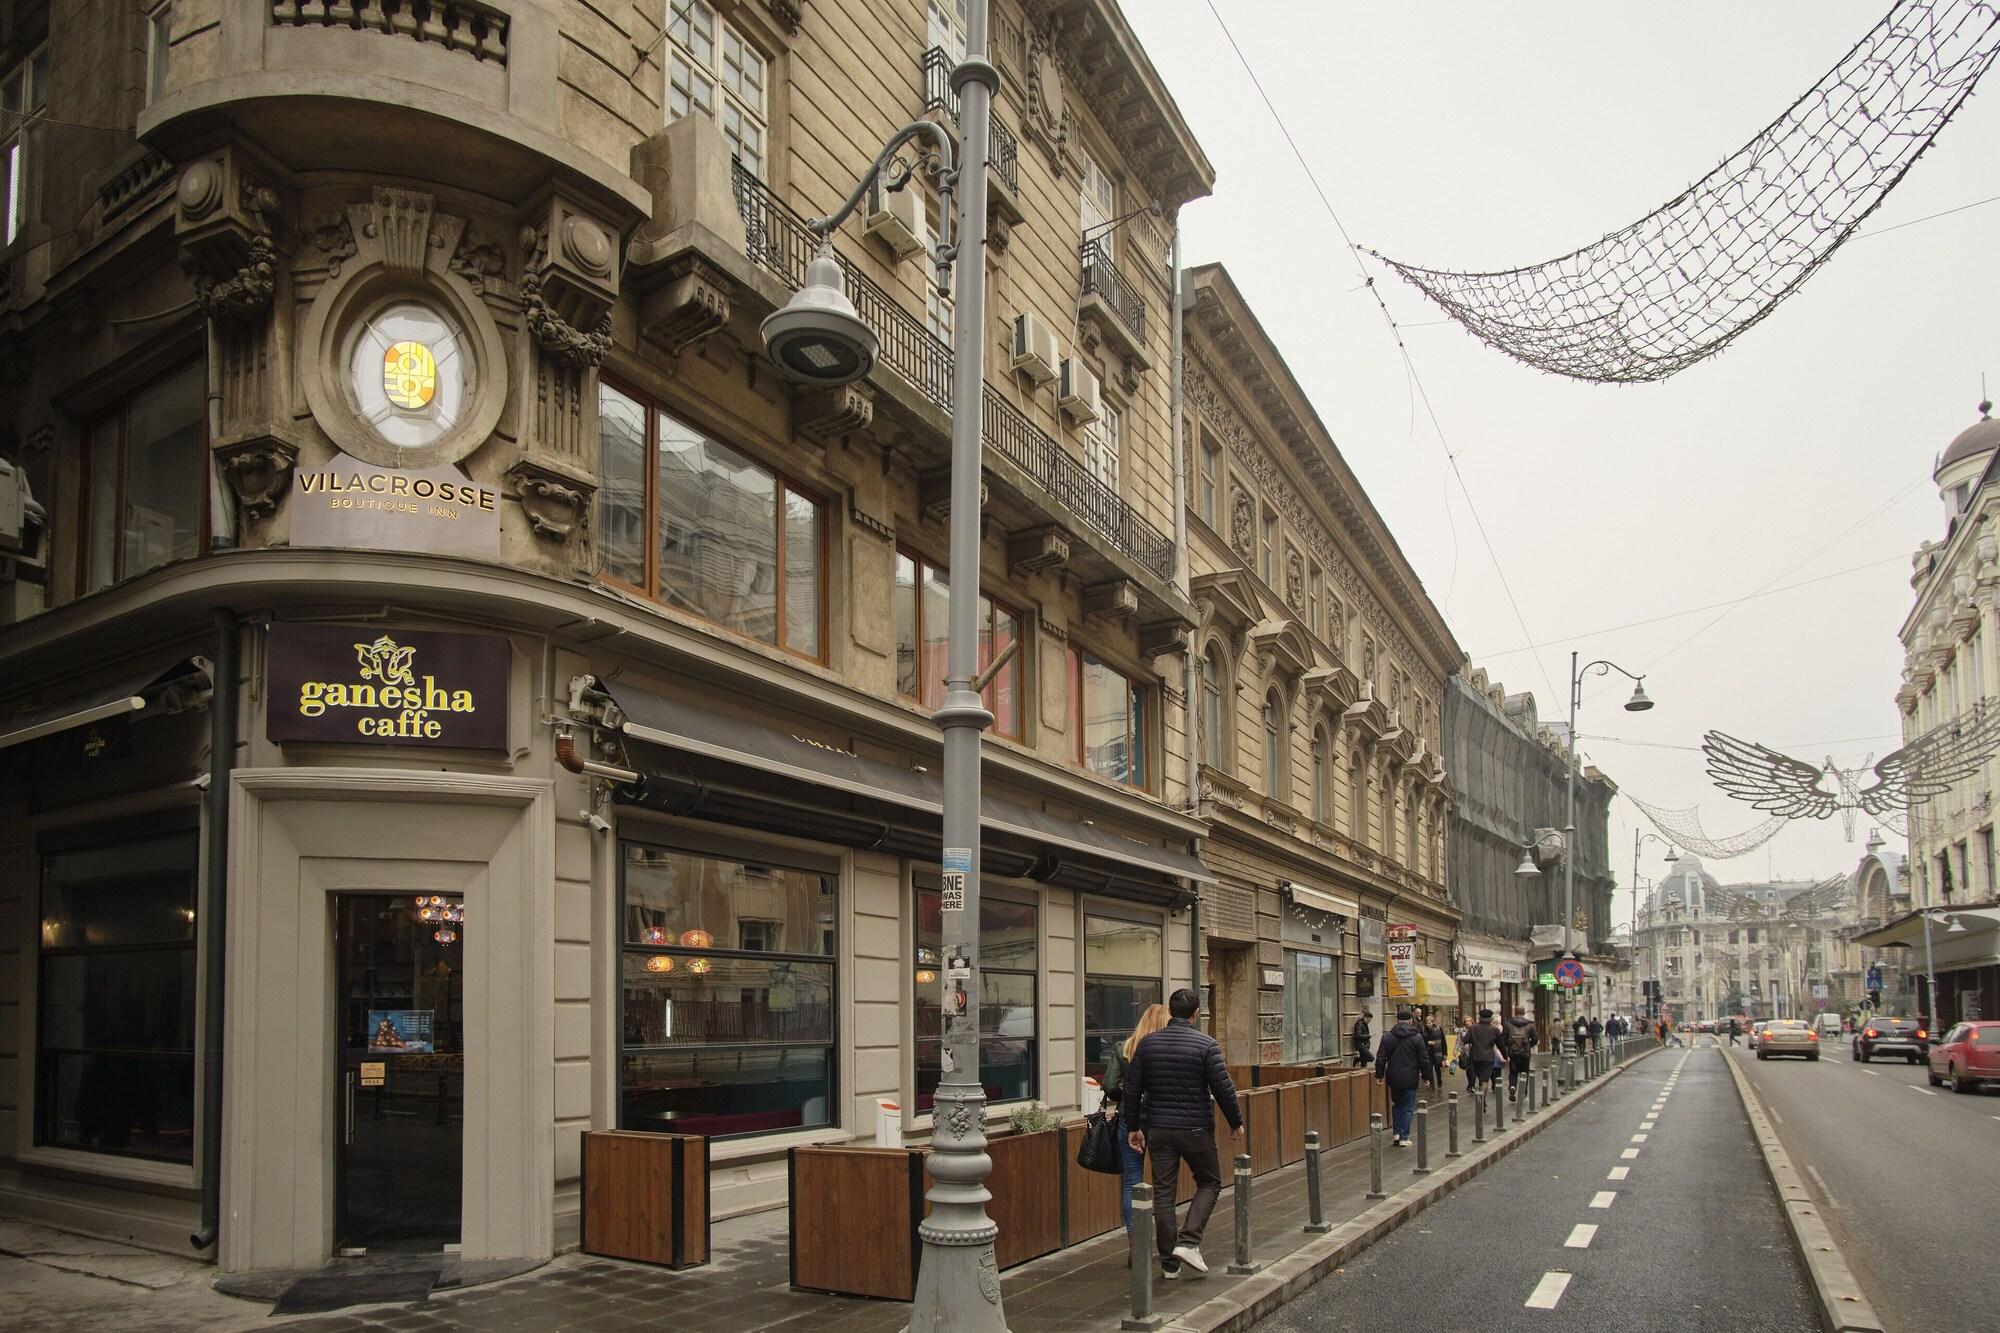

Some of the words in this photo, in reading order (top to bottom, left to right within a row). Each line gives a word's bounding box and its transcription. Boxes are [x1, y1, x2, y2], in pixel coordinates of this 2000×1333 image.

[299, 472, 496, 511] VILACROSSE
[330, 498, 419, 514] BOUTIQUE
[427, 506, 459, 520] INN
[299, 675, 476, 718] ganesha
[358, 709, 443, 739] caffe
[942, 875, 962, 891] BNE
[942, 891, 962, 900] WAS
